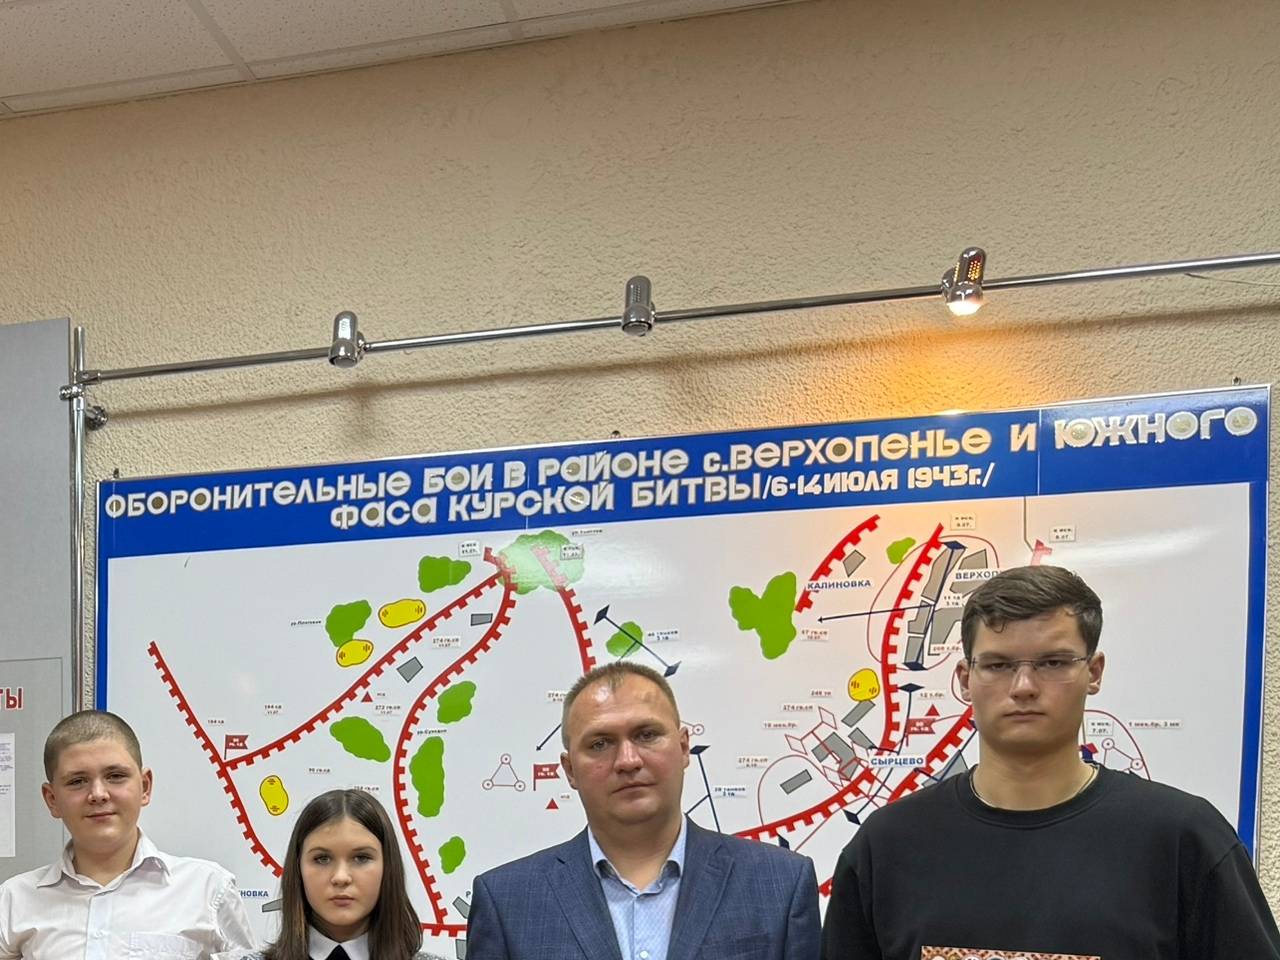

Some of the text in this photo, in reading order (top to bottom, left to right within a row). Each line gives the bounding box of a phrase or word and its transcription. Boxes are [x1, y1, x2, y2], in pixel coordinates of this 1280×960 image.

[105, 470, 412, 518] ОБОРОНИТЕЛЬНЫЕ
[422, 463, 494, 495] БОИ
[503, 460, 526, 489] В
[538, 449, 689, 486] РАЙОНЕ
[1010, 422, 1036, 453] И
[1054, 406, 1258, 449] ЮЖНОГО
[330, 497, 437, 530] ФАСА
[448, 482, 614, 522] КУРСКОЙ
[955, 570, 1002, 580] ВЕРХОП
[807, 579, 871, 590] КАЛИНОВКА
[870, 757, 924, 766] СЫРЦЕВО
